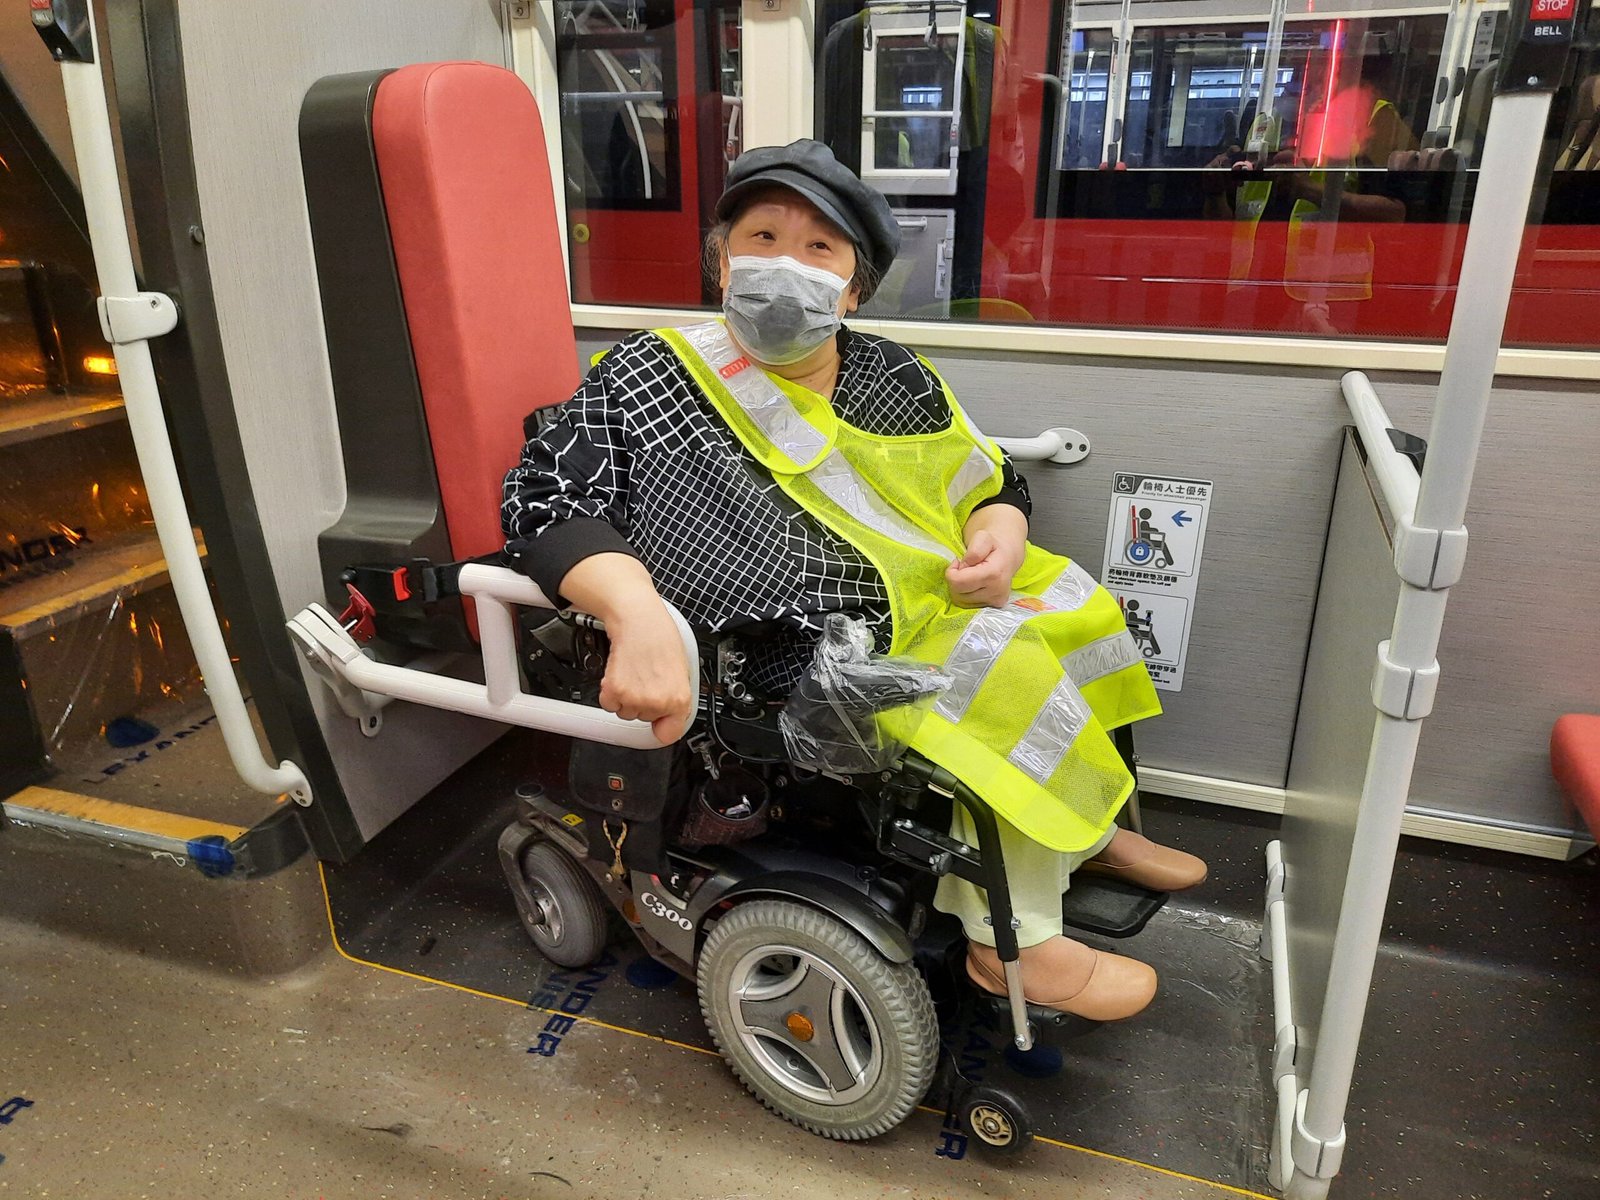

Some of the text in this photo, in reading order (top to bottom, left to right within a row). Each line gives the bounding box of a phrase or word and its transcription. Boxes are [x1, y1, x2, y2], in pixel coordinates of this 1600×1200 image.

[1536, 0, 1569, 12] STOP
[1534, 26, 1562, 36] BELL
[1143, 481, 1207, 496] 輪椅人士優先
[641, 892, 693, 931] C300
